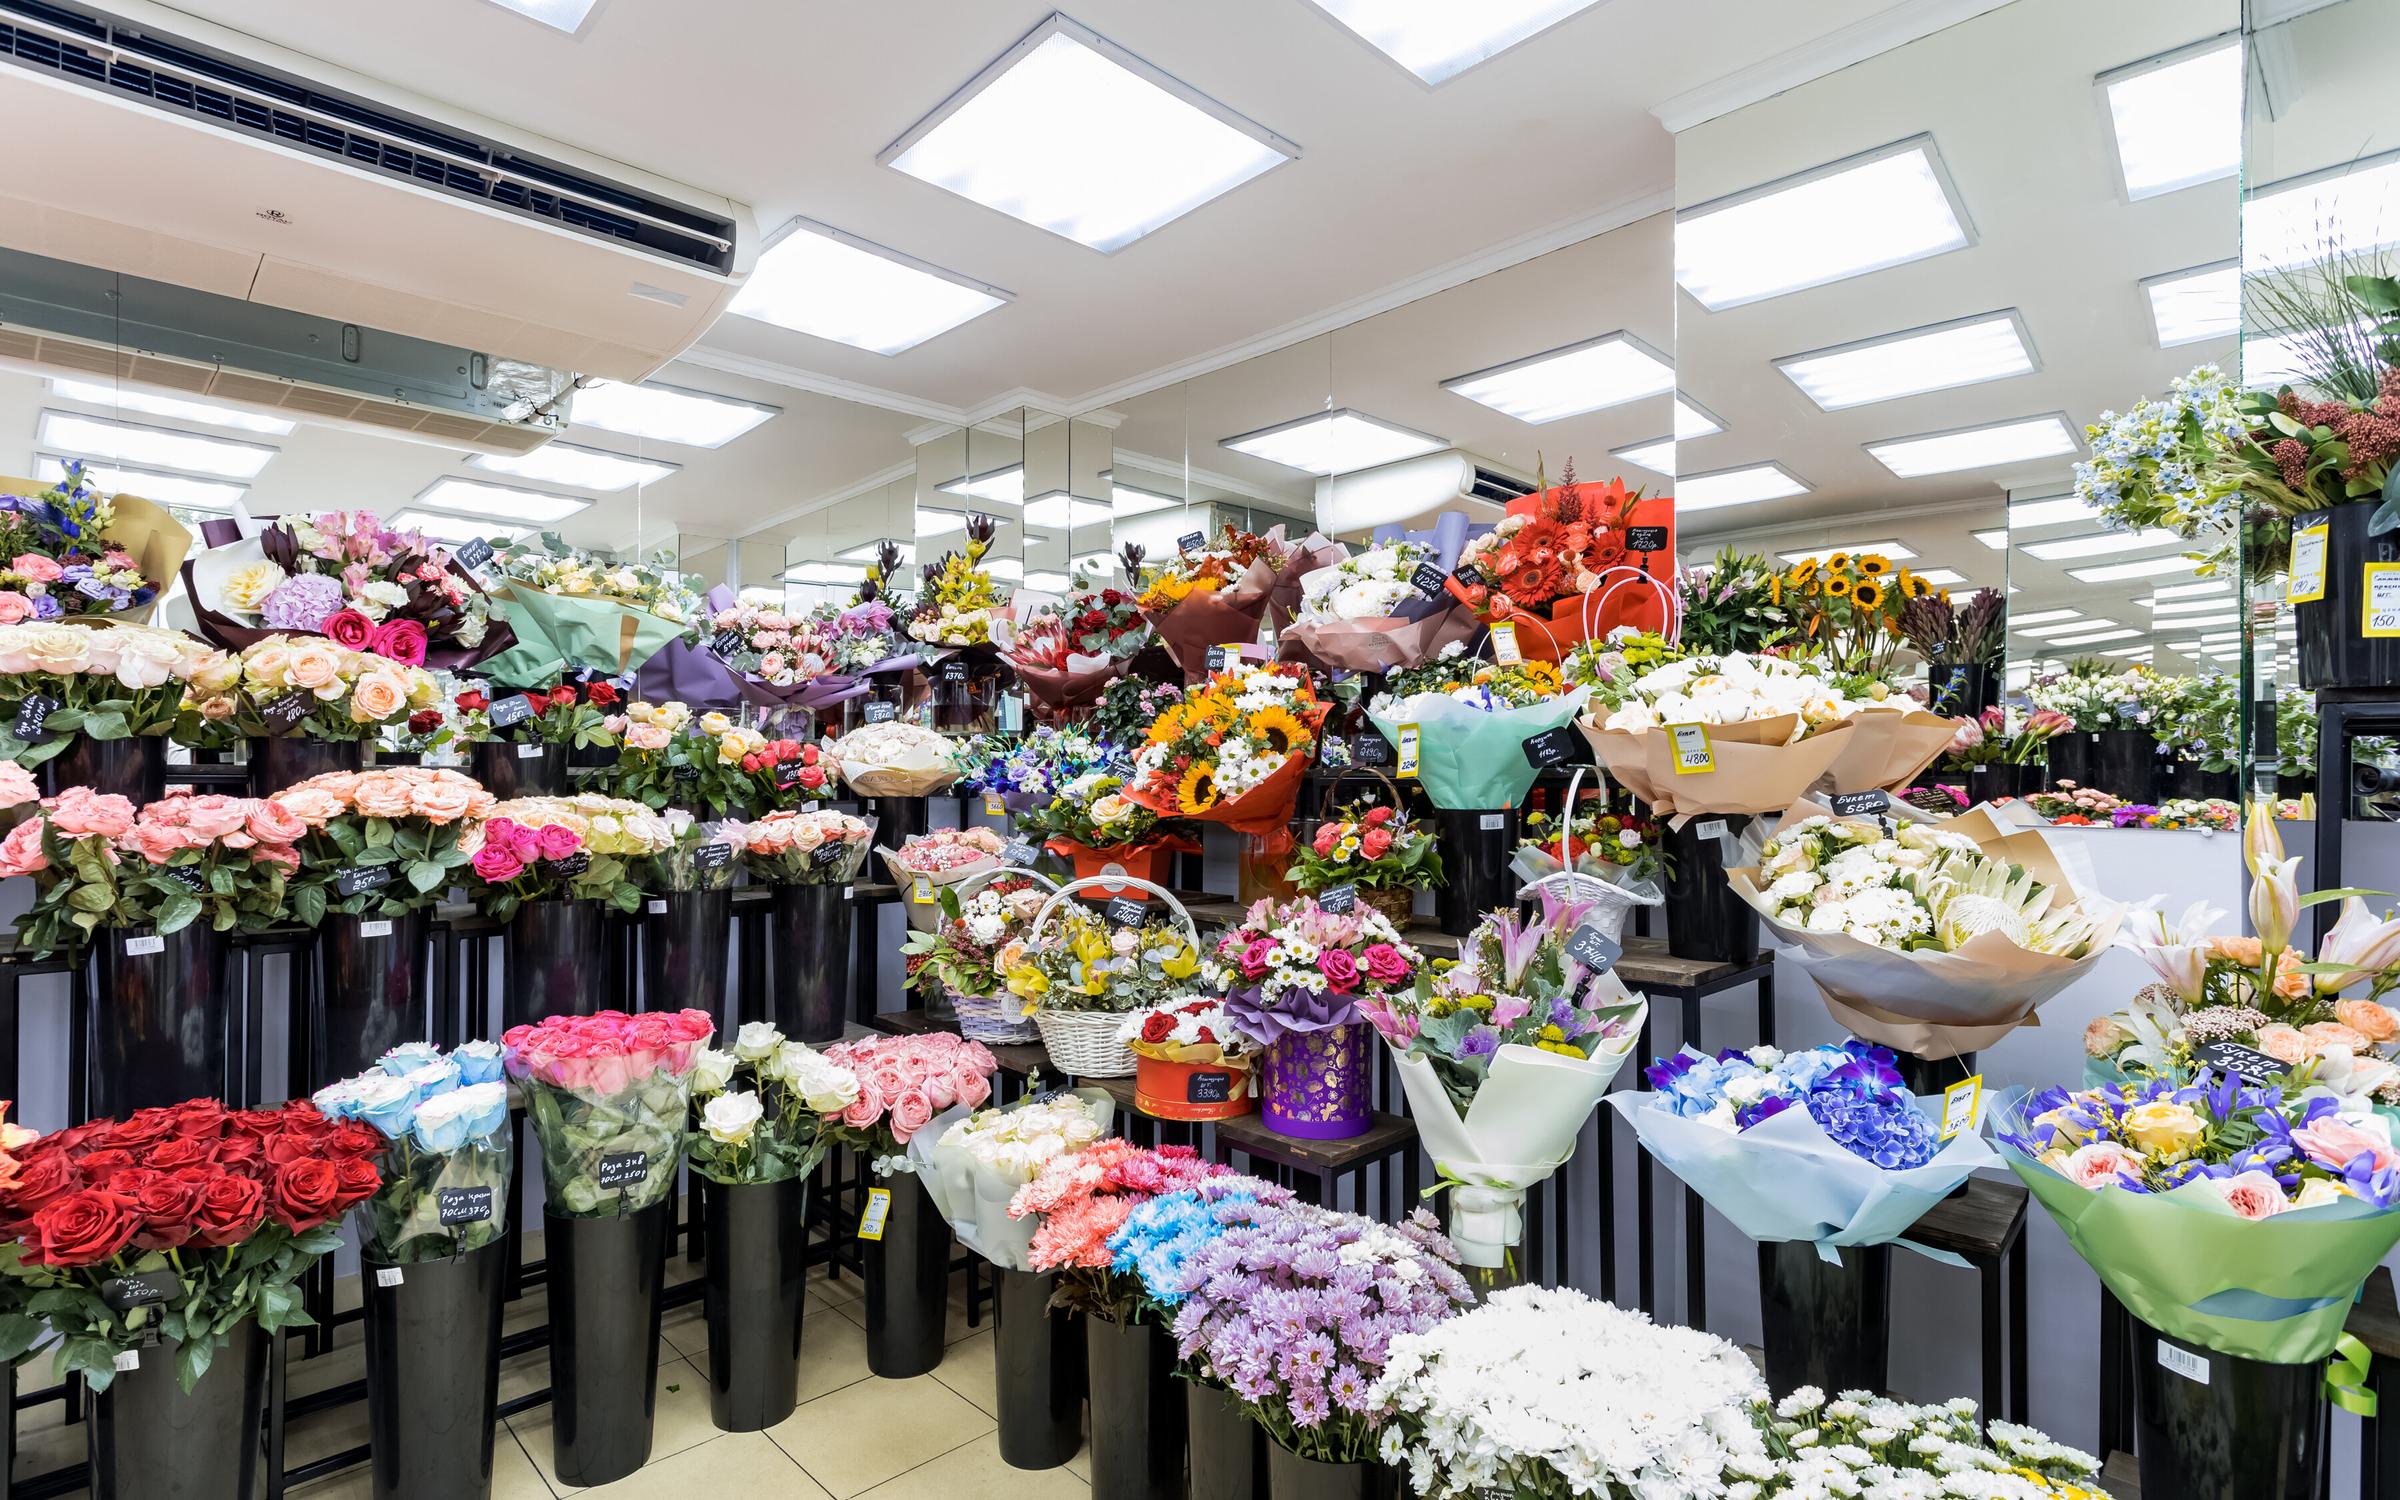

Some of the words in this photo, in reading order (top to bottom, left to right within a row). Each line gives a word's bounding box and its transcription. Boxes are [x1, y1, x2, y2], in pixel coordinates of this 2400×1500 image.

[1416, 573, 1441, 591] 4250
[1685, 752, 1710, 765] 4800
[1837, 794, 1876, 804] Букет
[2209, 1043, 2280, 1069] Букет
[602, 1162, 623, 1174] Роза
[442, 1193, 465, 1206] Роза
